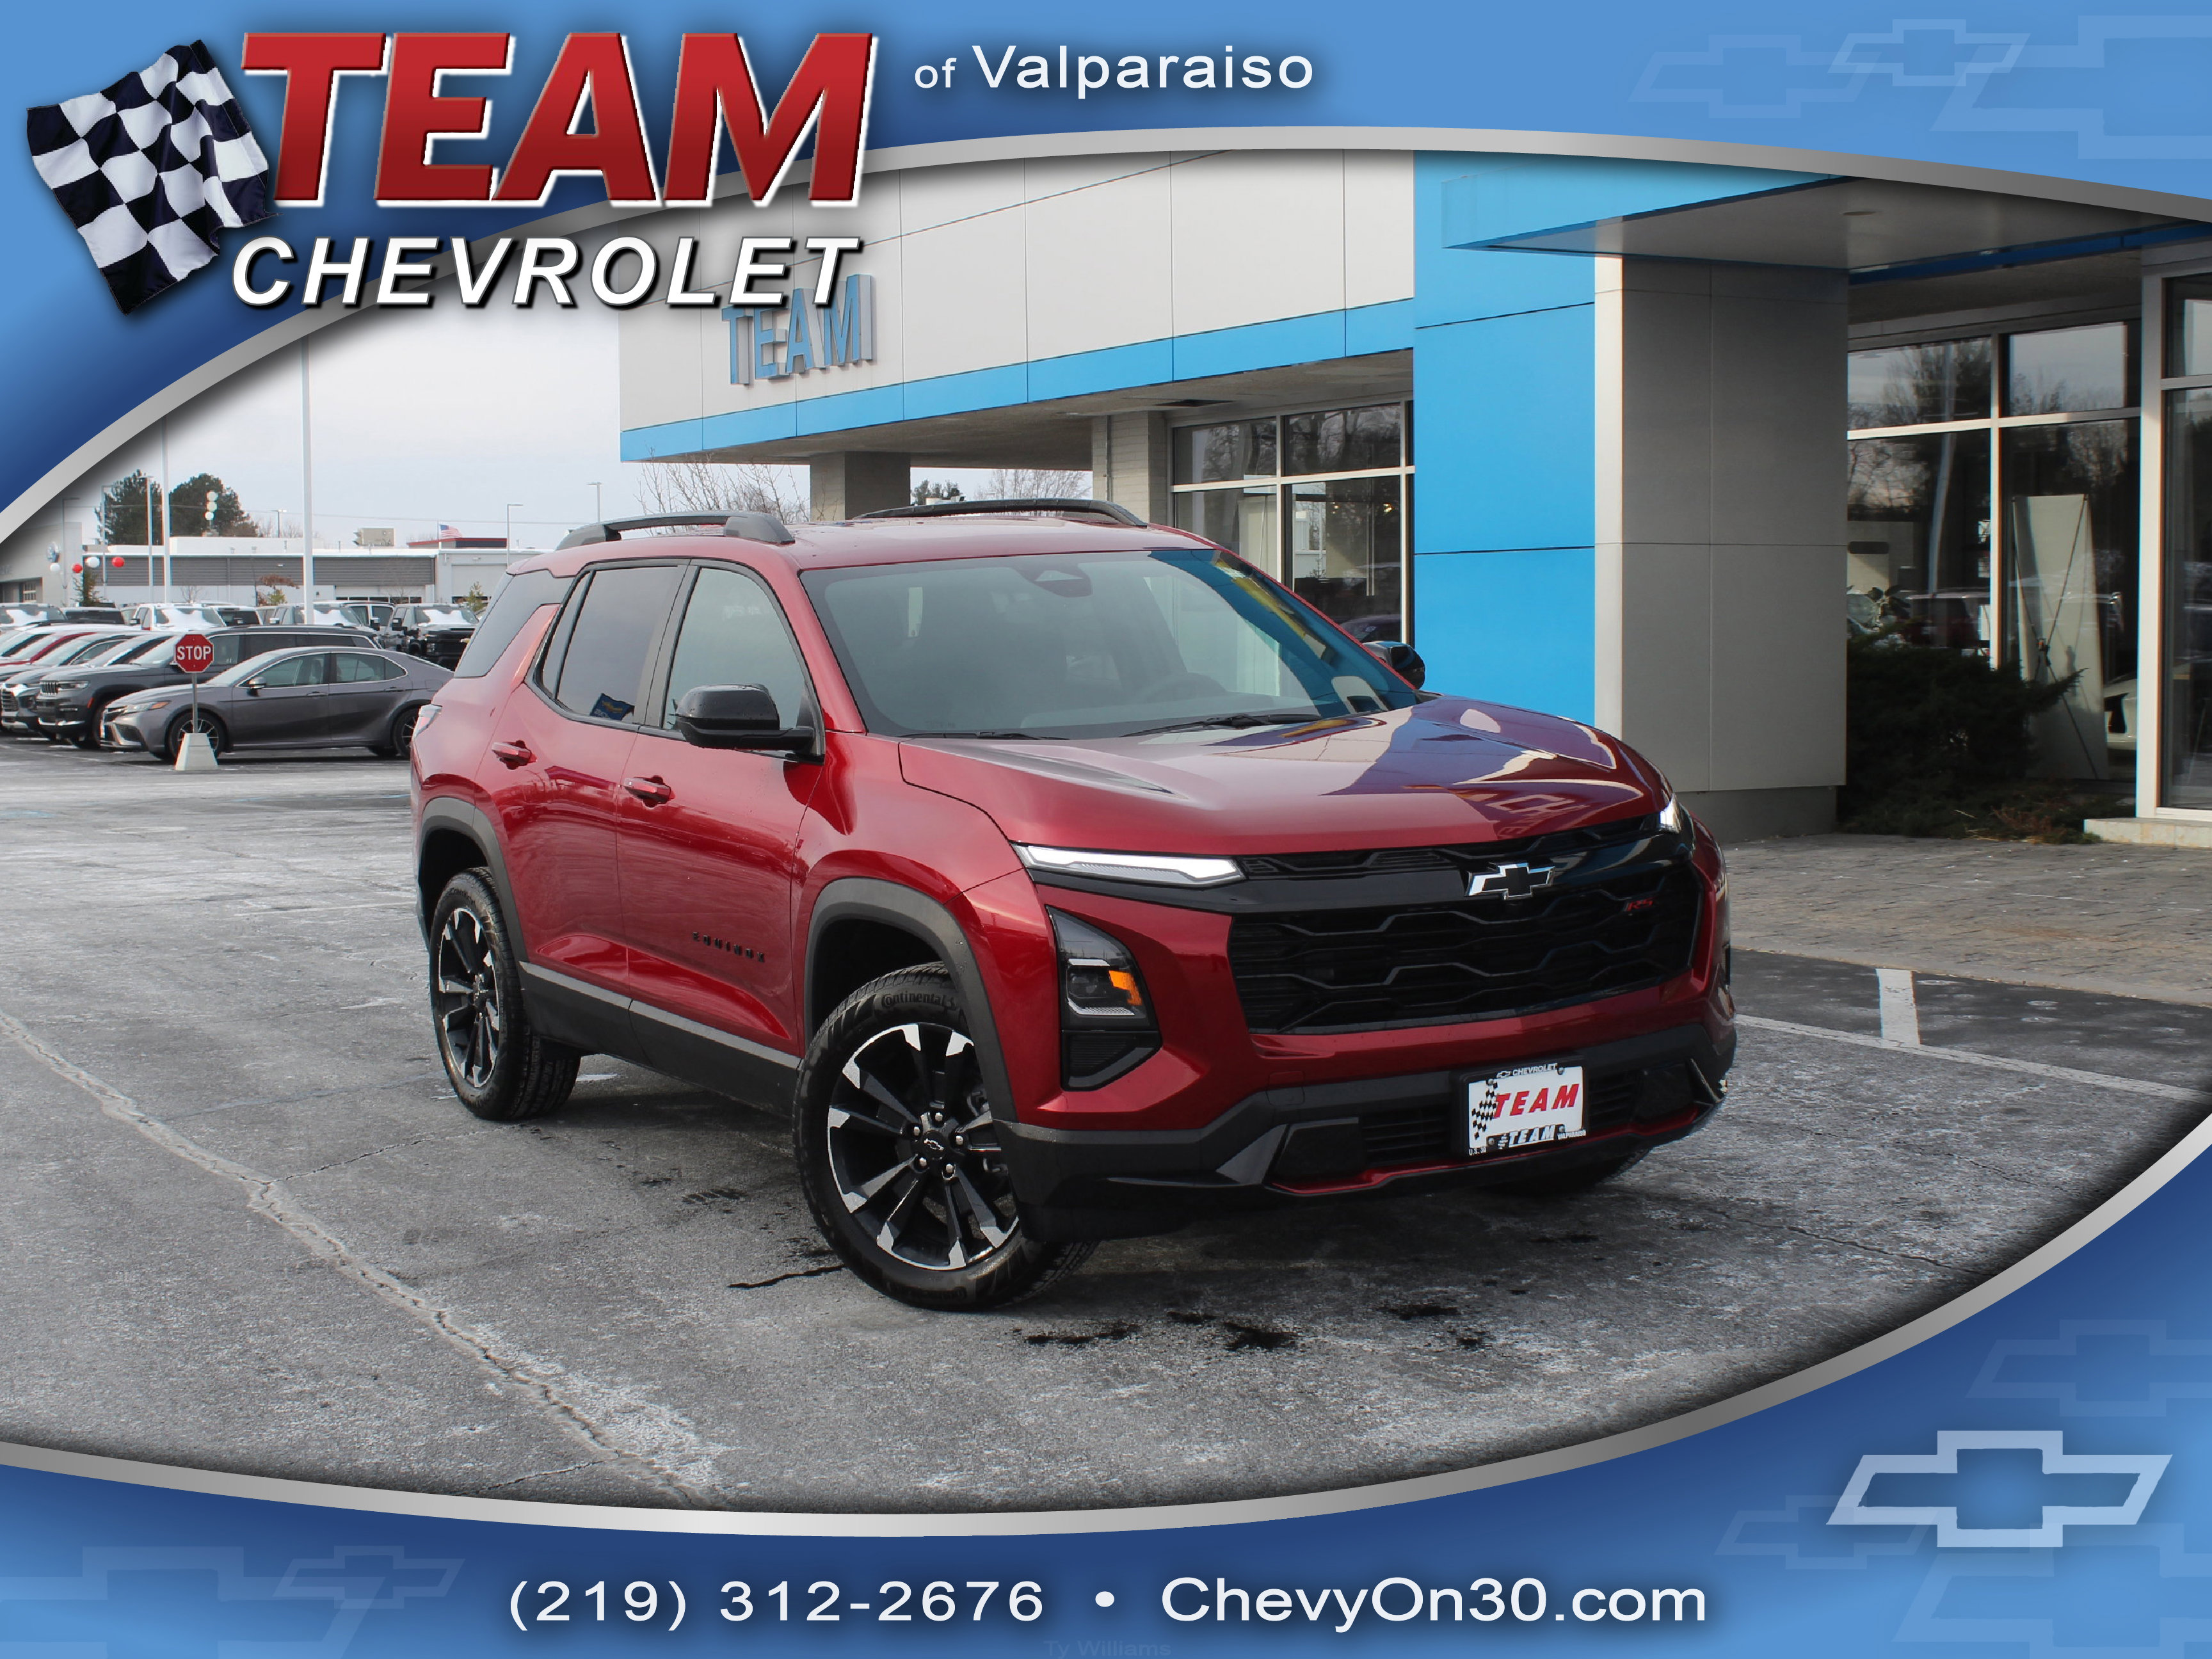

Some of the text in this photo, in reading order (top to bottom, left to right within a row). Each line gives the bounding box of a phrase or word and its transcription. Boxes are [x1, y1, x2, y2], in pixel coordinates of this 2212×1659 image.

[722, 274, 871, 385] TEAM
[177, 646, 211, 660] STOP
[1512, 1063, 1558, 1076] CHEVROLET
[1493, 1084, 1580, 1119] TEAM
[1508, 1125, 1556, 1145] TEAM
